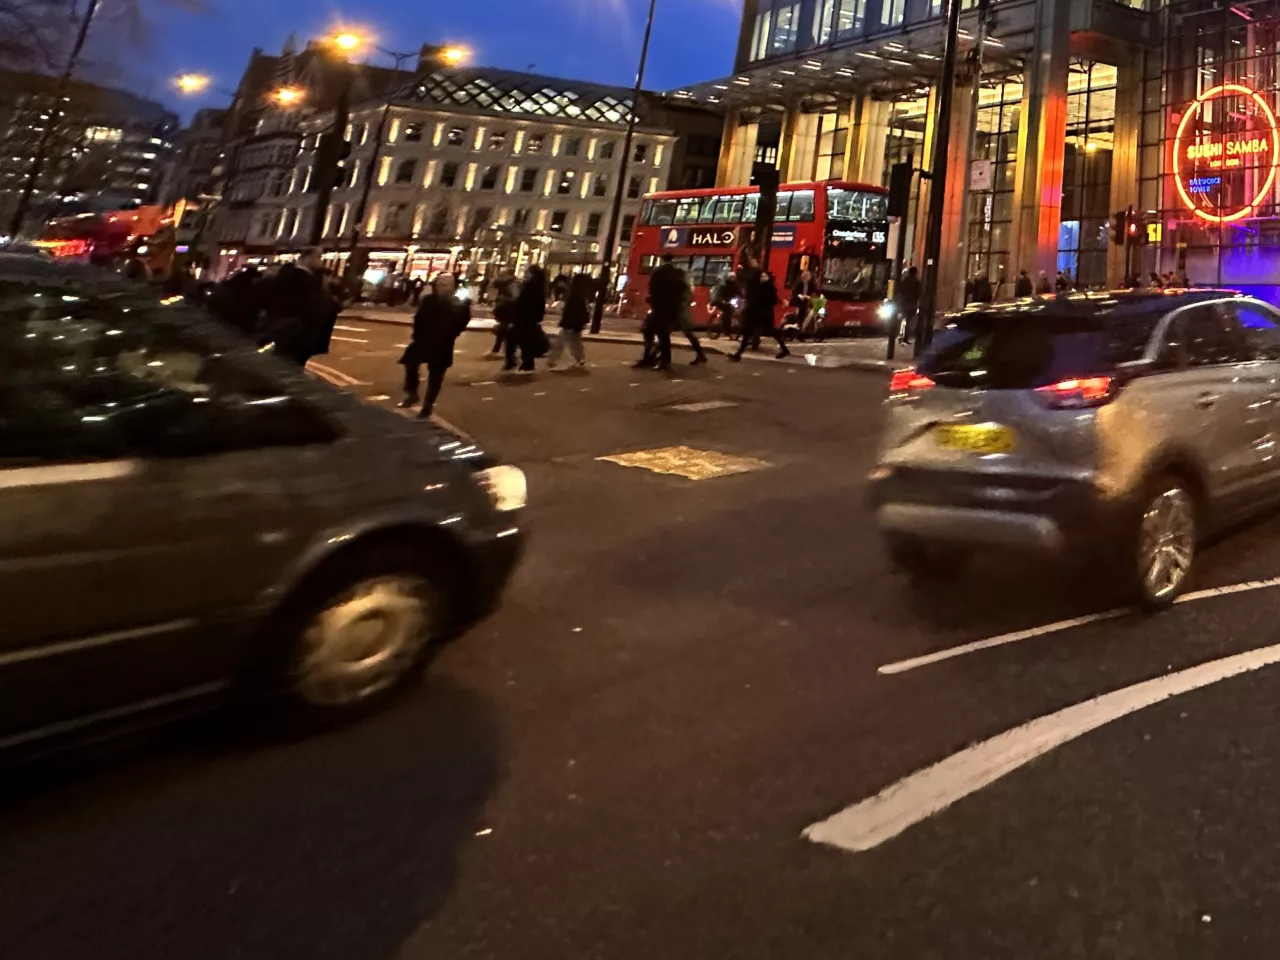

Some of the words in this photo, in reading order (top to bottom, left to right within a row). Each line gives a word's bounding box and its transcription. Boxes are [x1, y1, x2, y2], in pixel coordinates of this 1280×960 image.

[1187, 143, 1222, 159] SUSHI
[1226, 138, 1268, 155] SAMBA
[692, 231, 735, 244] HALO
